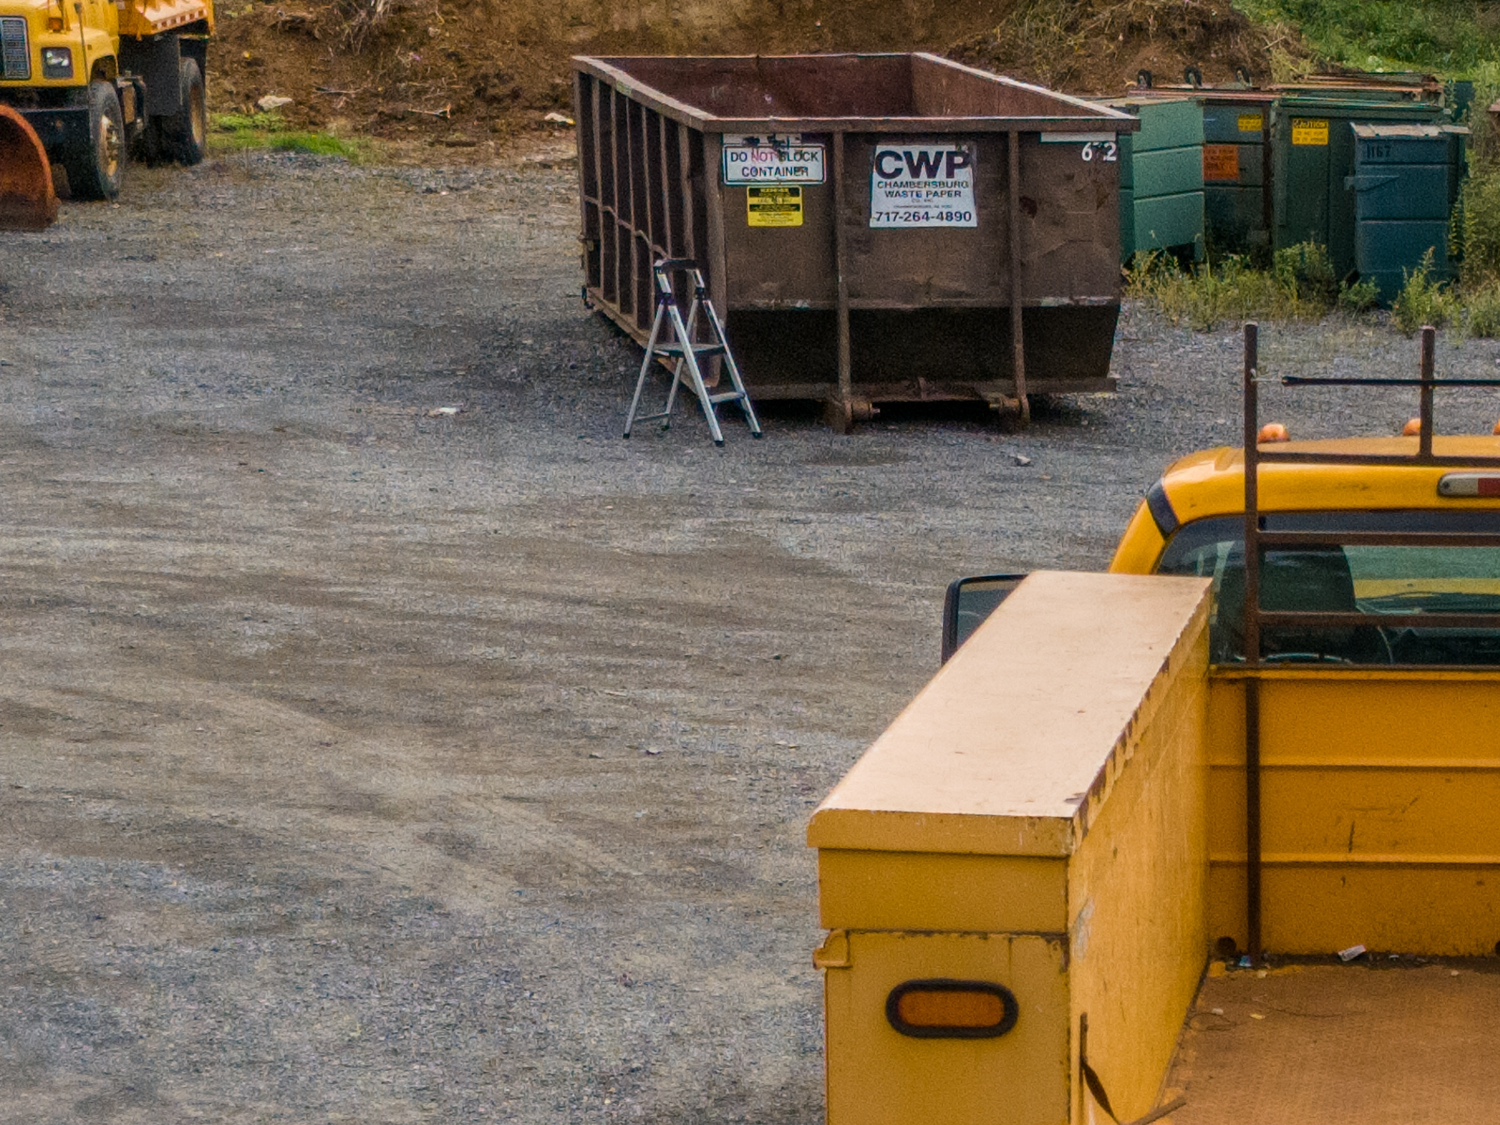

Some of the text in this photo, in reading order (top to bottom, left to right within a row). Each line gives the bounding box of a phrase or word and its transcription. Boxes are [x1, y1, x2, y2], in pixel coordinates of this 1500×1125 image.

[730, 151, 748, 162] DO
[751, 151, 775, 162] NOT
[875, 150, 970, 179] CWP
[741, 166, 809, 177] CONTAINER
[877, 180, 969, 189] CHAMBERSBURG
[885, 190, 962, 198] WASTE PAPER
[875, 211, 972, 222] 717-264-4890
